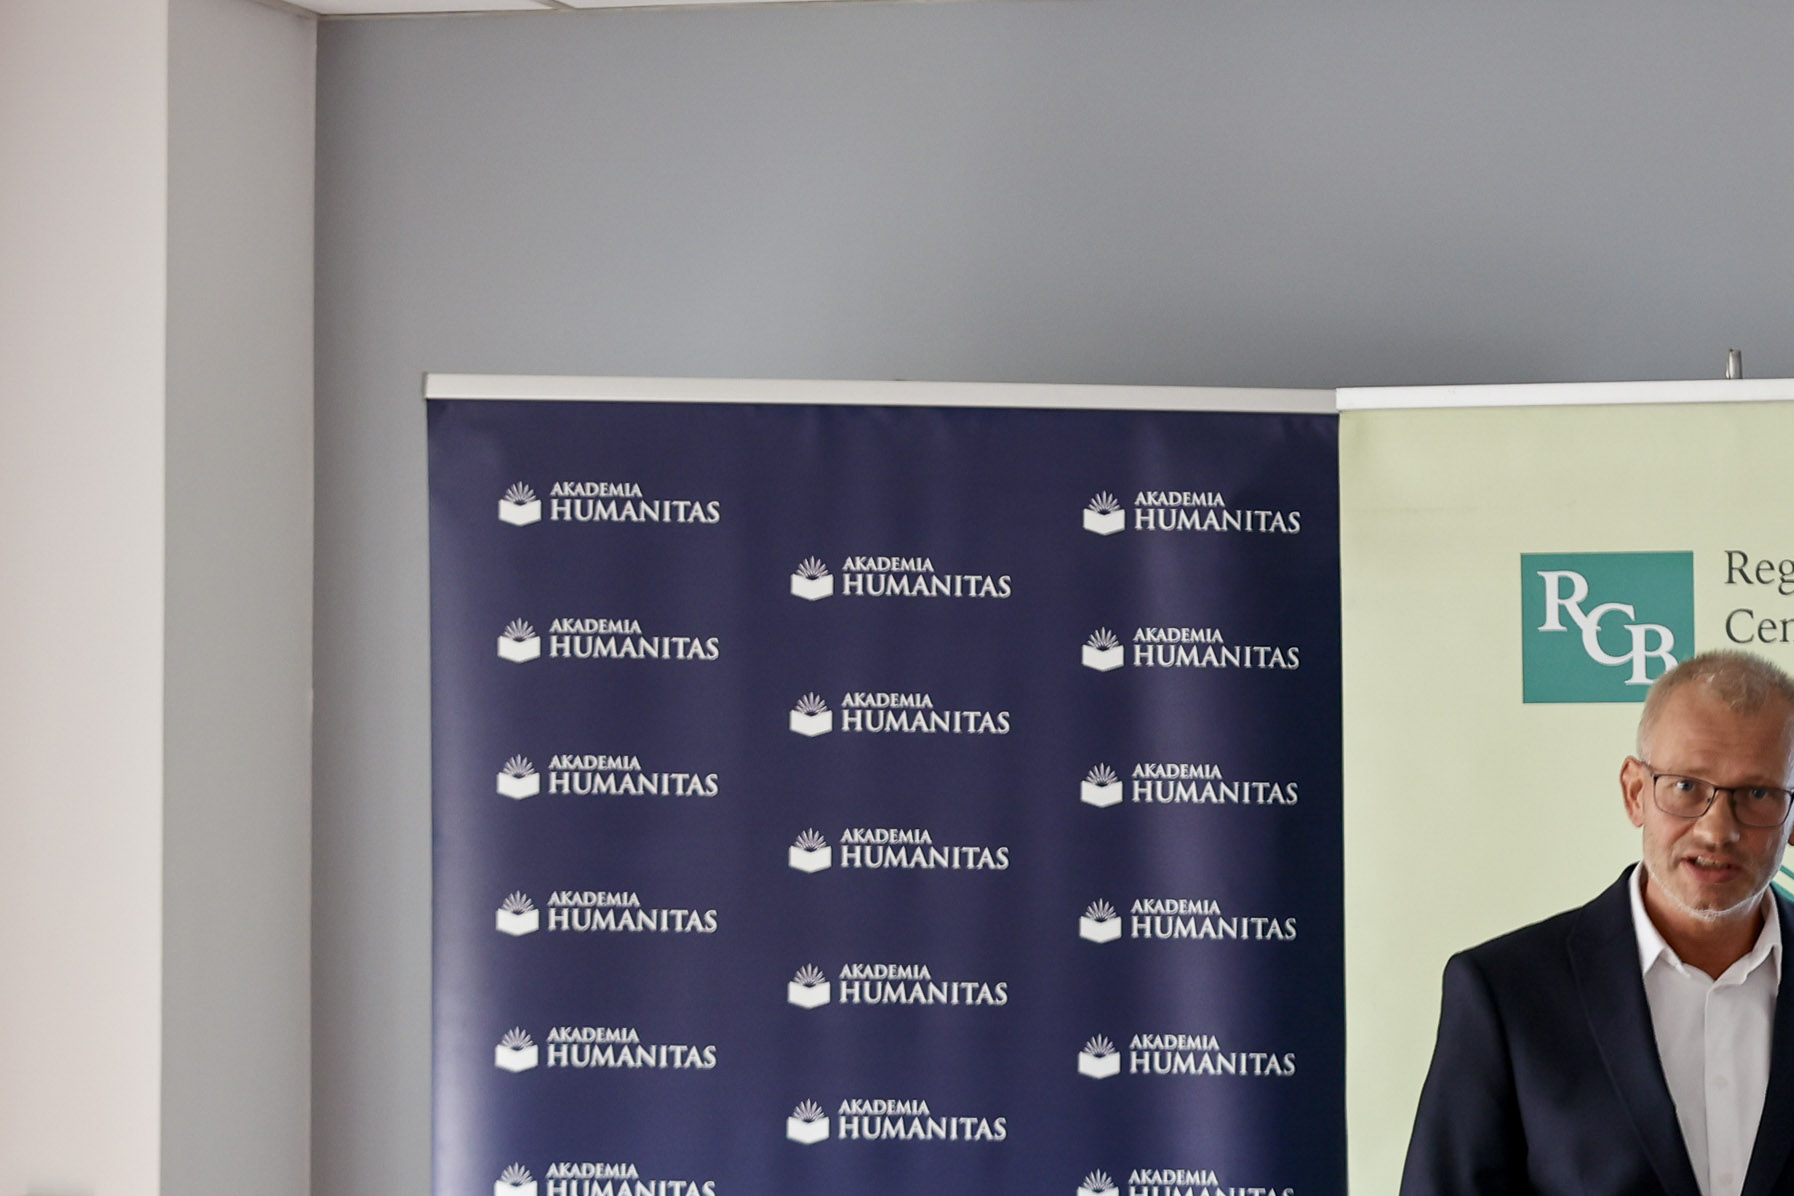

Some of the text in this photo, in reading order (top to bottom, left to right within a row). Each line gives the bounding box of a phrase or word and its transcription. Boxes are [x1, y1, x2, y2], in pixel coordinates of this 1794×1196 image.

[550, 481, 643, 498] AKADEMIA
[1134, 491, 1225, 507] AKADEMIA
[550, 500, 720, 524] HUMANITAS
[1134, 510, 1301, 533] HUMANITAS
[842, 556, 935, 573] AKADEMIA
[842, 574, 1011, 598] HUMANITAS
[549, 618, 642, 635] AKADEMIA
[1132, 627, 1224, 644] AKADEMIA
[549, 636, 719, 661] HUMANITAS
[1133, 646, 1300, 669] HUMANITAS
[841, 692, 934, 709] AKADEMIA
[841, 710, 1010, 734] HUMANITAS
[548, 754, 642, 771] AKADEMIA
[1131, 763, 1223, 780] AKADEMIA
[548, 772, 719, 797] HUMANITAS
[1132, 781, 1298, 805] HUMANITAS
[840, 828, 933, 845] AKADEMIA
[840, 845, 1009, 870] HUMANITAS
[547, 890, 641, 908] AKADEMIA
[1130, 898, 1221, 916] AKADEMIA
[548, 908, 718, 933] HUMANITAS
[1131, 916, 1297, 940] HUMANITAS
[839, 963, 931, 980] AKADEMIA
[839, 982, 1008, 1006] HUMANITAS
[546, 1026, 640, 1044] AKADEMIA
[1129, 1034, 1220, 1051] AKADEMIA
[547, 1045, 717, 1069] HUMANITAS
[1130, 1052, 1295, 1076] HUMANITAS
[838, 1098, 930, 1118] AKADEMIA
[838, 1118, 1007, 1141] HUMANITAS
[545, 1162, 639, 1180] AKADEMIA
[1128, 1169, 1219, 1187] AKADEMIA
